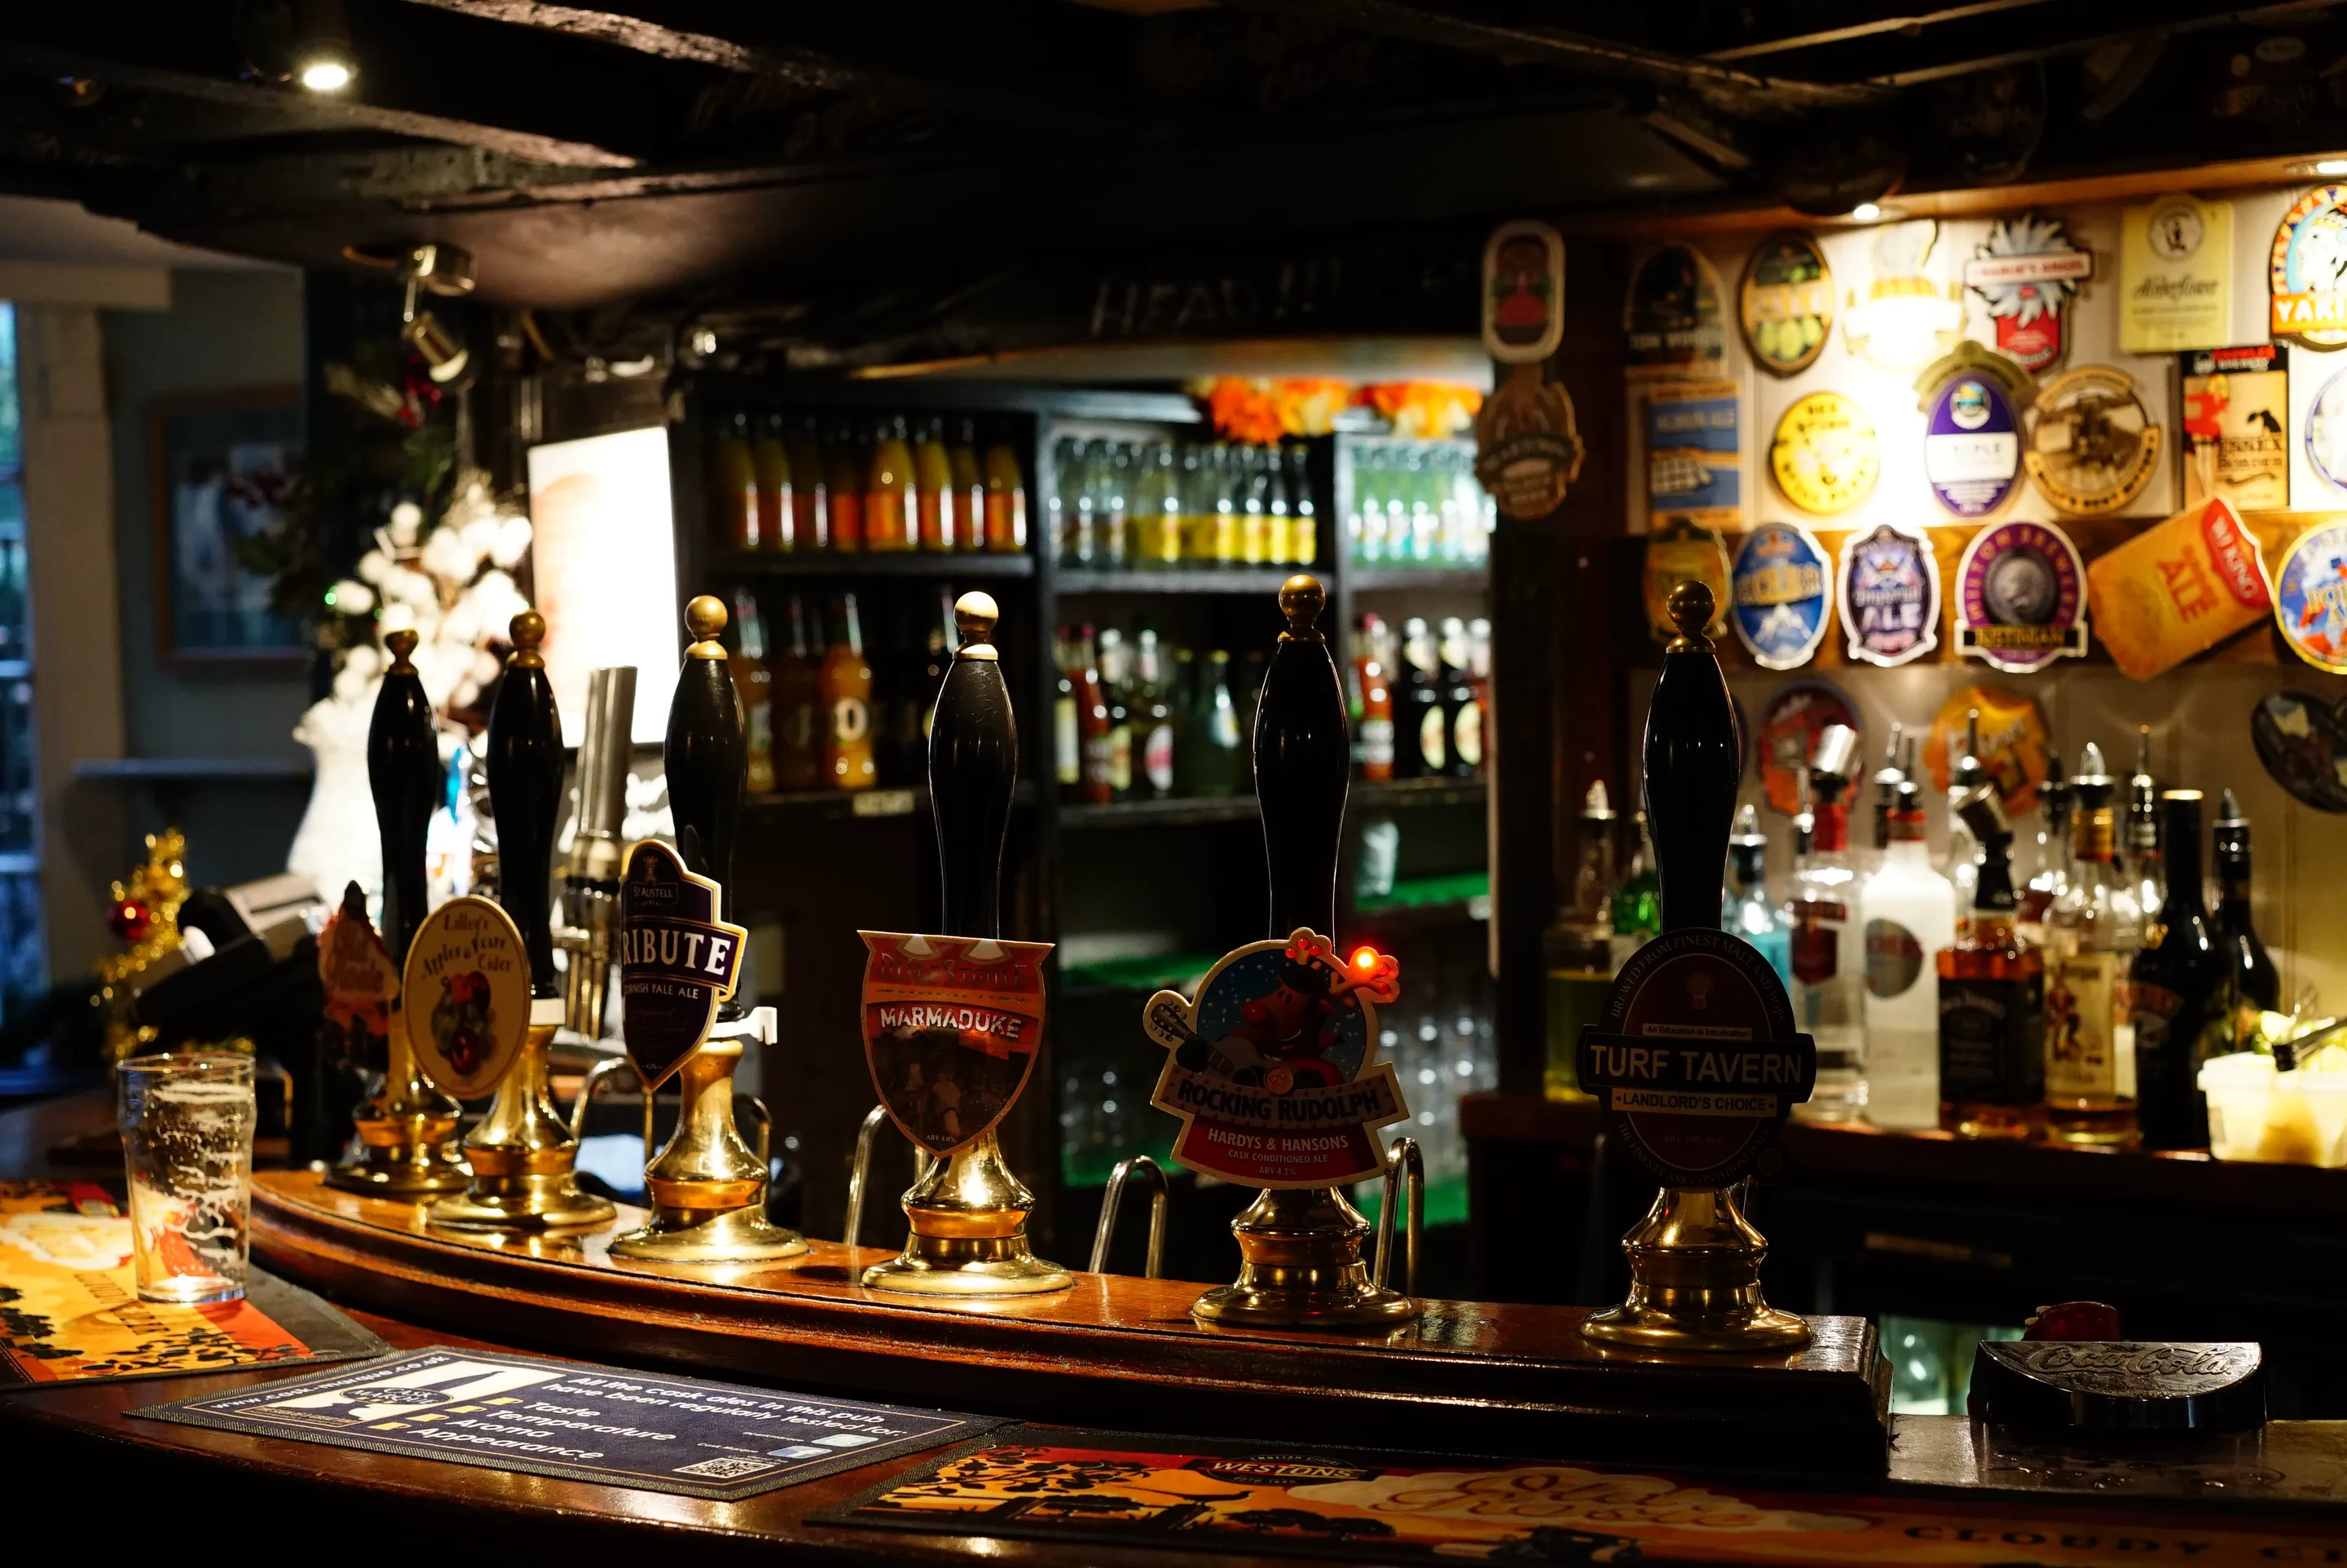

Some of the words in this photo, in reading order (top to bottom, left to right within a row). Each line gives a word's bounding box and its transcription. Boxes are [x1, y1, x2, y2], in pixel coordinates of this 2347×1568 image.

[1610, 967, 1641, 1019] BREWED
[1638, 940, 1673, 971] FROM
[1674, 934, 1720, 949] FINEST
[1720, 939, 1755, 966] MALT
[1751, 965, 1773, 991] AND
[652, 983, 674, 996] PALE
[677, 987, 700, 1000] ALE
[880, 1007, 1022, 1040] MARMADUKE
[1659, 1026, 1695, 1035] Education
[1706, 1028, 1747, 1037] Intoxication
[1590, 1045, 1670, 1079] TURF
[1680, 1050, 1803, 1084] TAVERN
[1178, 1078, 1271, 1121] ROCKING
[1279, 1088, 1380, 1121] RUDOLPH
[1623, 1092, 1711, 1110] LANDLORD'S
[1715, 1097, 1767, 1112] CHOICE
[1208, 1128, 1262, 1151] HARDYS
[1266, 1137, 1277, 1151] &
[1282, 1134, 1349, 1152] HANSONS
[1228, 1149, 1250, 1161] CASK
[1252, 1152, 1310, 1164] CONDITIONED
[1313, 1154, 1328, 1164] ALE
[1259, 1165, 1275, 1175] ABV
[1276, 1166, 1297, 1176] 4.2%
[522, 1402, 601, 1417] Taste
[541, 1383, 604, 1397] have
[604, 1391, 670, 1405] been
[669, 1401, 782, 1420] regularly
[780, 1414, 865, 1430] tested
[567, 1376, 608, 1386] All
[602, 1381, 643, 1392] the
[645, 1388, 707, 1400] cask
[706, 1394, 759, 1407] ales
[758, 1402, 785, 1411] in
[786, 1405, 832, 1416] this
[832, 1412, 886, 1423] pub
[445, 1419, 556, 1438] Aroma
[486, 1410, 677, 1441] Temperature
[407, 1427, 605, 1459] Appearance
[1213, 1462, 1352, 1478] WESTONS
[1904, 1526, 2209, 1556] CLOUDY
